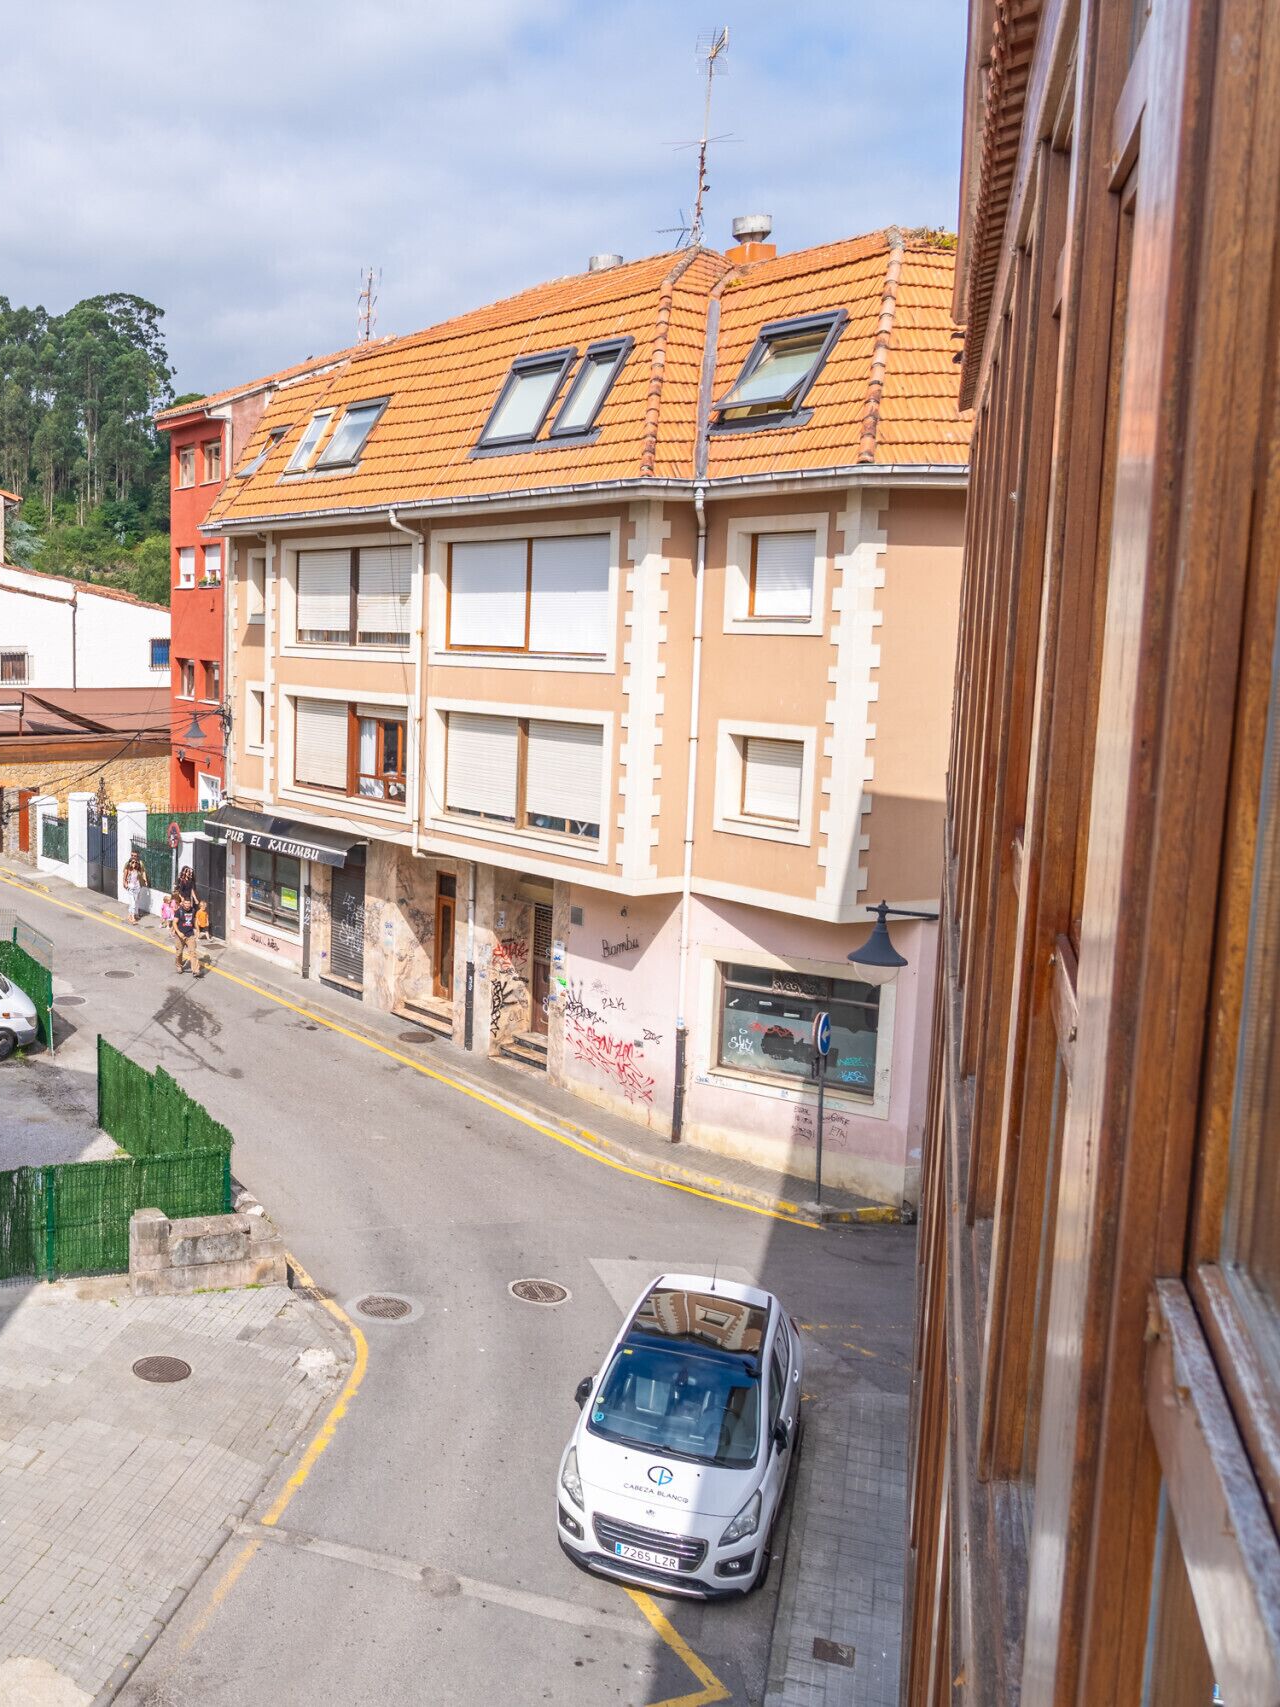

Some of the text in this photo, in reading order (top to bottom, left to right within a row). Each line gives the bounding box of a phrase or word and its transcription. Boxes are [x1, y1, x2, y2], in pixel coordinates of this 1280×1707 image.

[225, 829, 320, 860] PUB EL KALUMBU
[601, 934, 640, 958] Bambu
[623, 1482, 654, 1494] CABEZA
[623, 1546, 676, 1568] 7265 LZR
